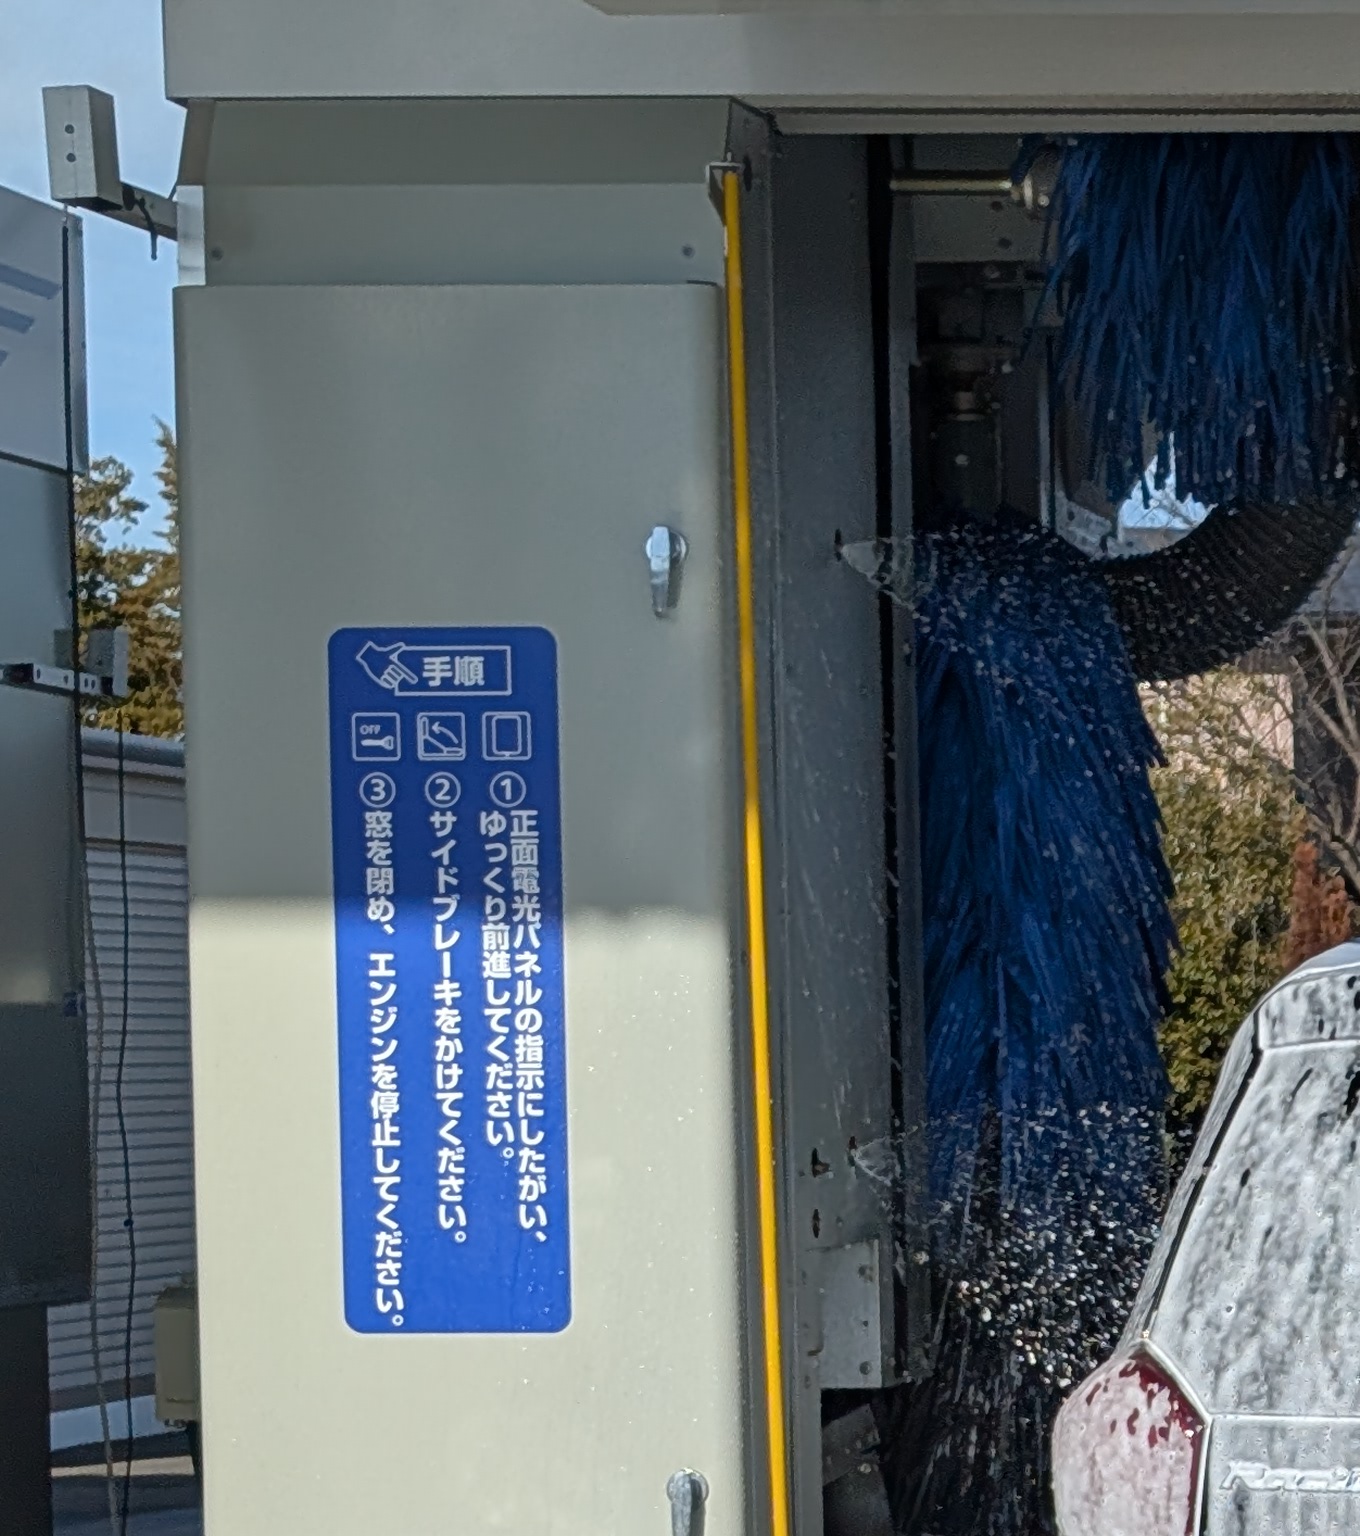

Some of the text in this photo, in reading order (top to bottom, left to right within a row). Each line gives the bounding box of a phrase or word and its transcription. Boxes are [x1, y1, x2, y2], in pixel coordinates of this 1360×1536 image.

[422, 655, 485, 687] 手順
[479, 810, 515, 1159] ゆっくり前進してください。
